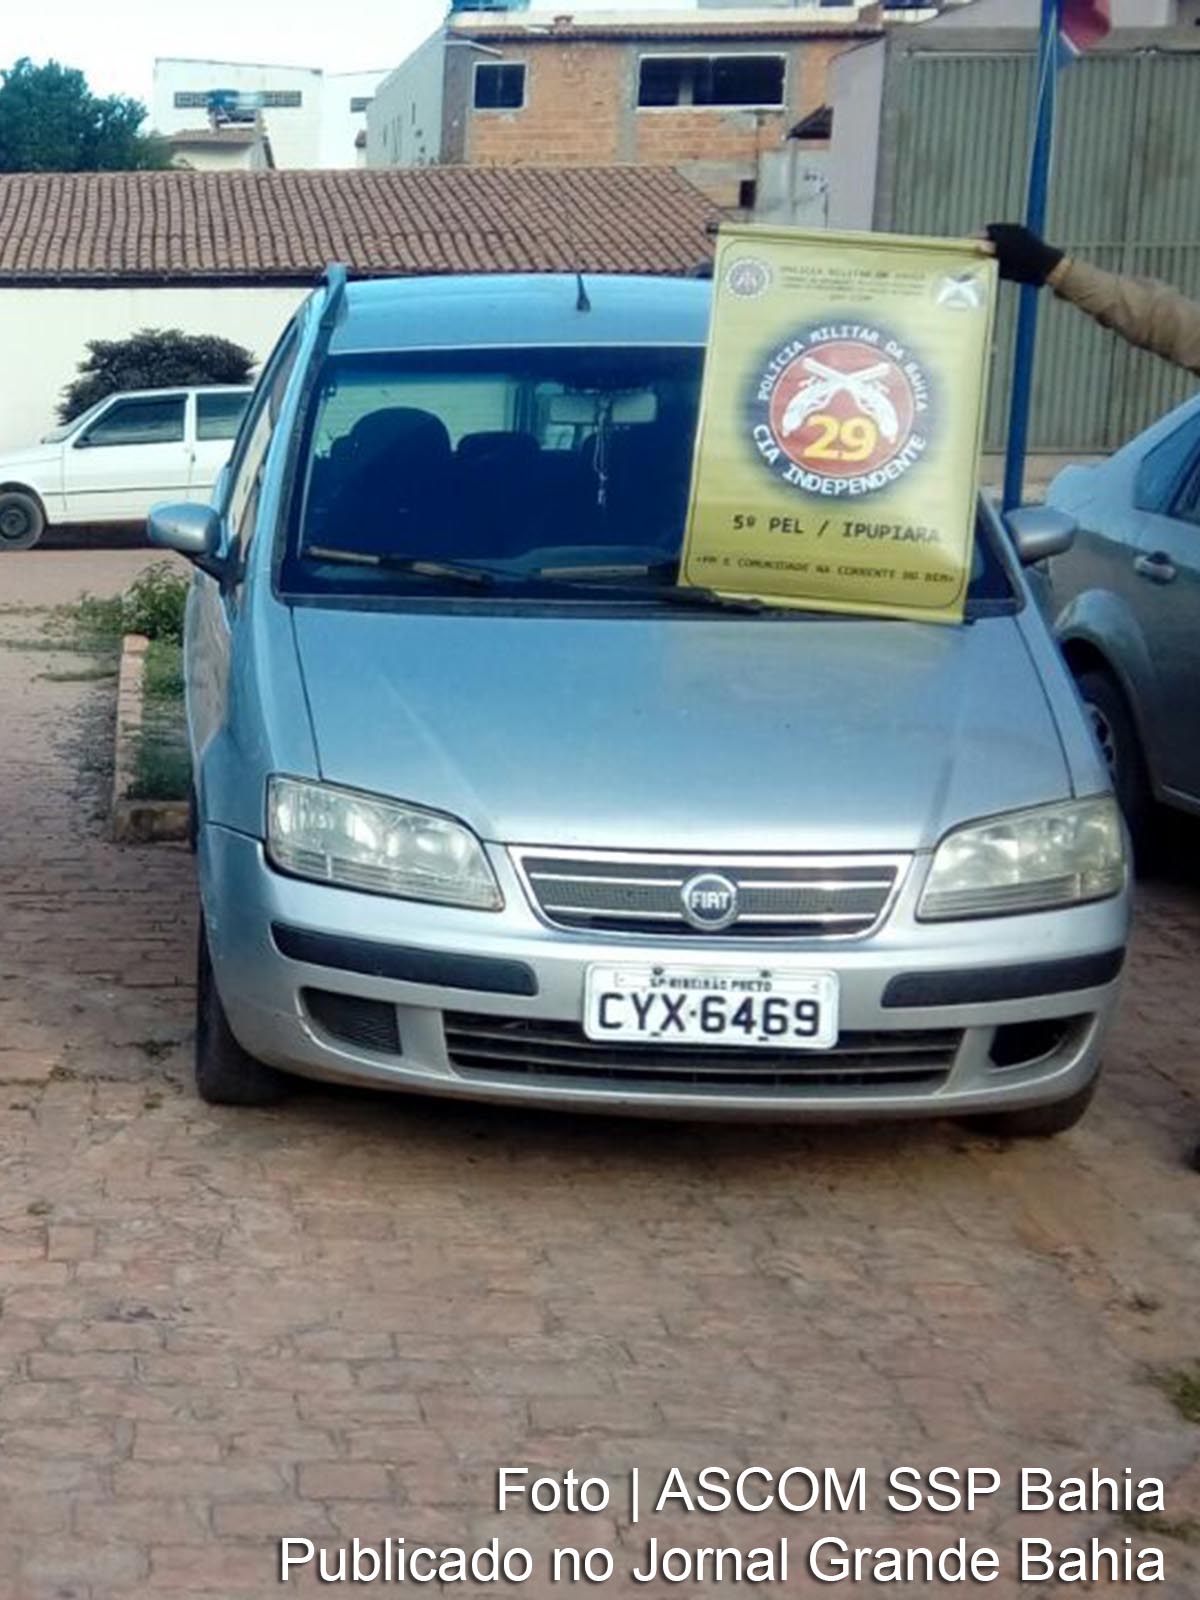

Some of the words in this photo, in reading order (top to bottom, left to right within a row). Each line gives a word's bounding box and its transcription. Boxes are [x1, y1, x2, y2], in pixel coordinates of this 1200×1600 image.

[757, 340, 806, 401] POLICIA
[809, 325, 880, 343] MILITAR
[884, 339, 905, 361] DA
[903, 360, 929, 413] BAHIA
[803, 414, 877, 462] 29
[753, 424, 780, 465] CIA
[782, 433, 927, 495] INDEPENDENTE
[768, 517, 804, 534] PEL
[817, 520, 830, 537] /
[842, 521, 940, 543] IPUPIARA
[738, 559, 809, 573] COMUNIDADE
[838, 567, 896, 579] CORRENTE
[691, 891, 729, 909] FIAT
